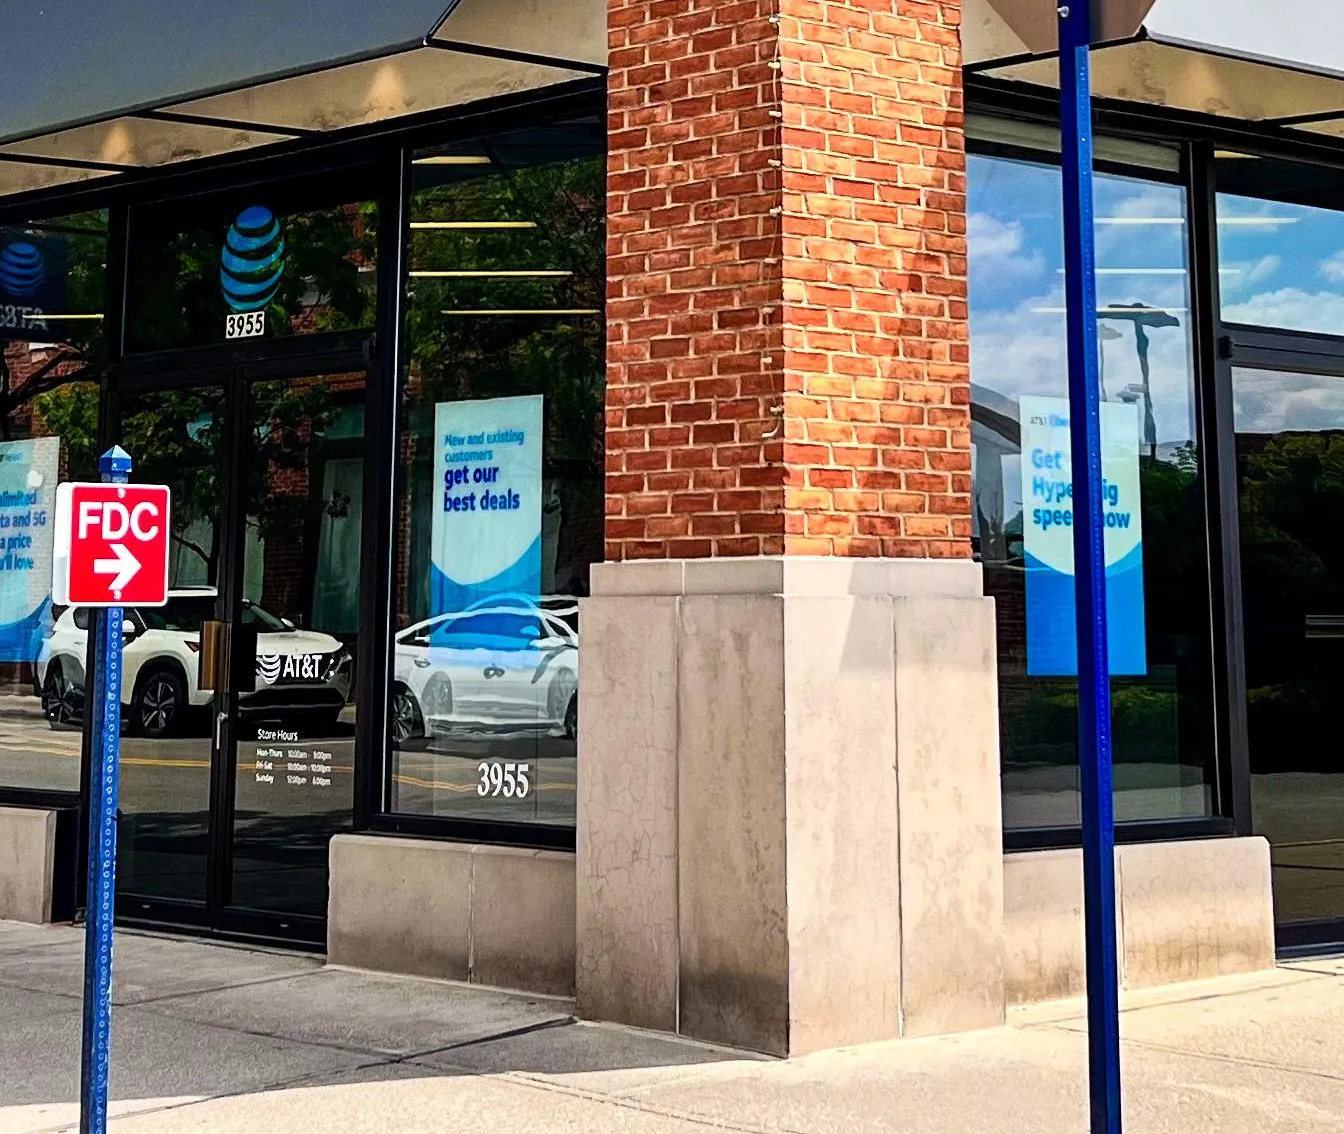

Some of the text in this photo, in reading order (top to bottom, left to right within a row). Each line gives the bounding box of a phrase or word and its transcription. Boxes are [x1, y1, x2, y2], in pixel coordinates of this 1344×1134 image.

[227, 314, 263, 336] 3955
[445, 429, 525, 446] New and existing
[445, 450, 493, 463] customers
[1032, 448, 1063, 469] Get
[444, 466, 500, 490] get our
[444, 488, 520, 512] best deals
[13, 511, 31, 527] and
[33, 511, 47, 526] 5G
[78, 501, 159, 542] FDC
[1103, 512, 1130, 528] ow
[0, 537, 7, 549] a
[7, 534, 32, 551] price
[14, 554, 34, 571] love
[282, 654, 322, 678] AT&T
[257, 728, 298, 741] Store Hours
[477, 762, 529, 798] 3955
